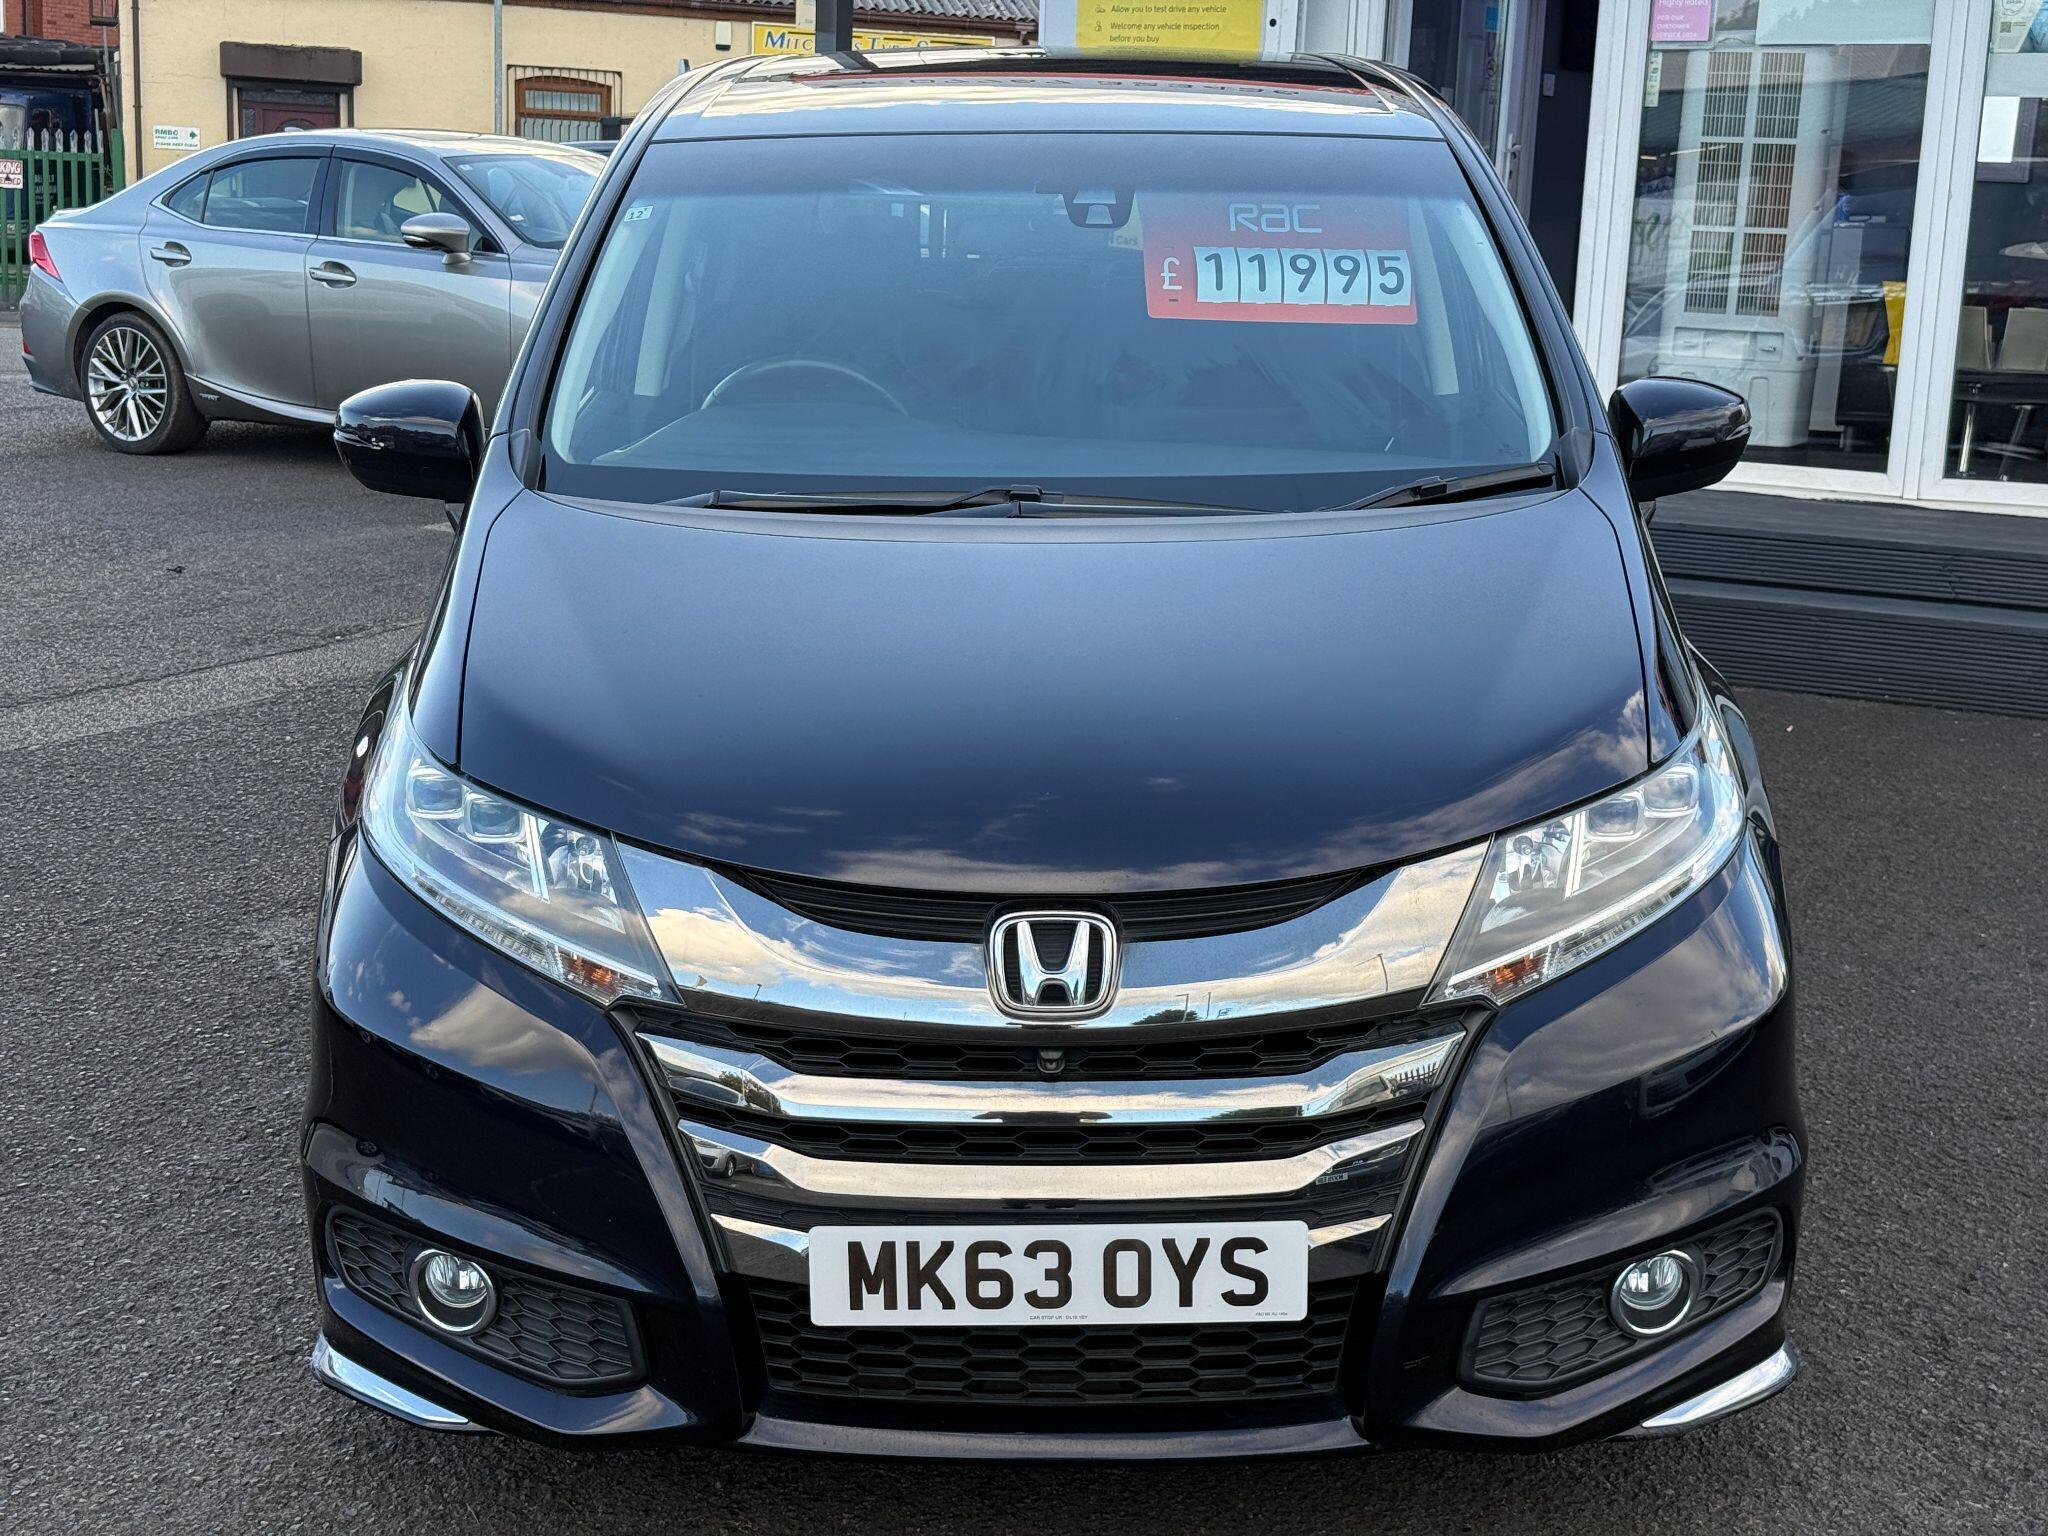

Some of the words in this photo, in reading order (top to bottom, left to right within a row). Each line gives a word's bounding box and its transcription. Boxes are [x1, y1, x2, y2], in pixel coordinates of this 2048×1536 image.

[1111, 5, 1130, 13] Allow
[1131, 6, 1144, 14] you
[1145, 5, 1152, 13] to
[1154, 5, 1167, 13] test
[1169, 5, 1186, 13] drive
[1187, 6, 1201, 14] any
[1202, 5, 1227, 13] vehicle
[1110, 22, 1142, 30] Welcome
[1157, 22, 1182, 30] vehicle
[1183, 22, 1220, 31] inspection
[1146, 35, 1160, 44] buy
[1203, 252, 1405, 295] 11995
[847, 1239, 1073, 1311] MK63
[1102, 1236, 1270, 1308] OYS
